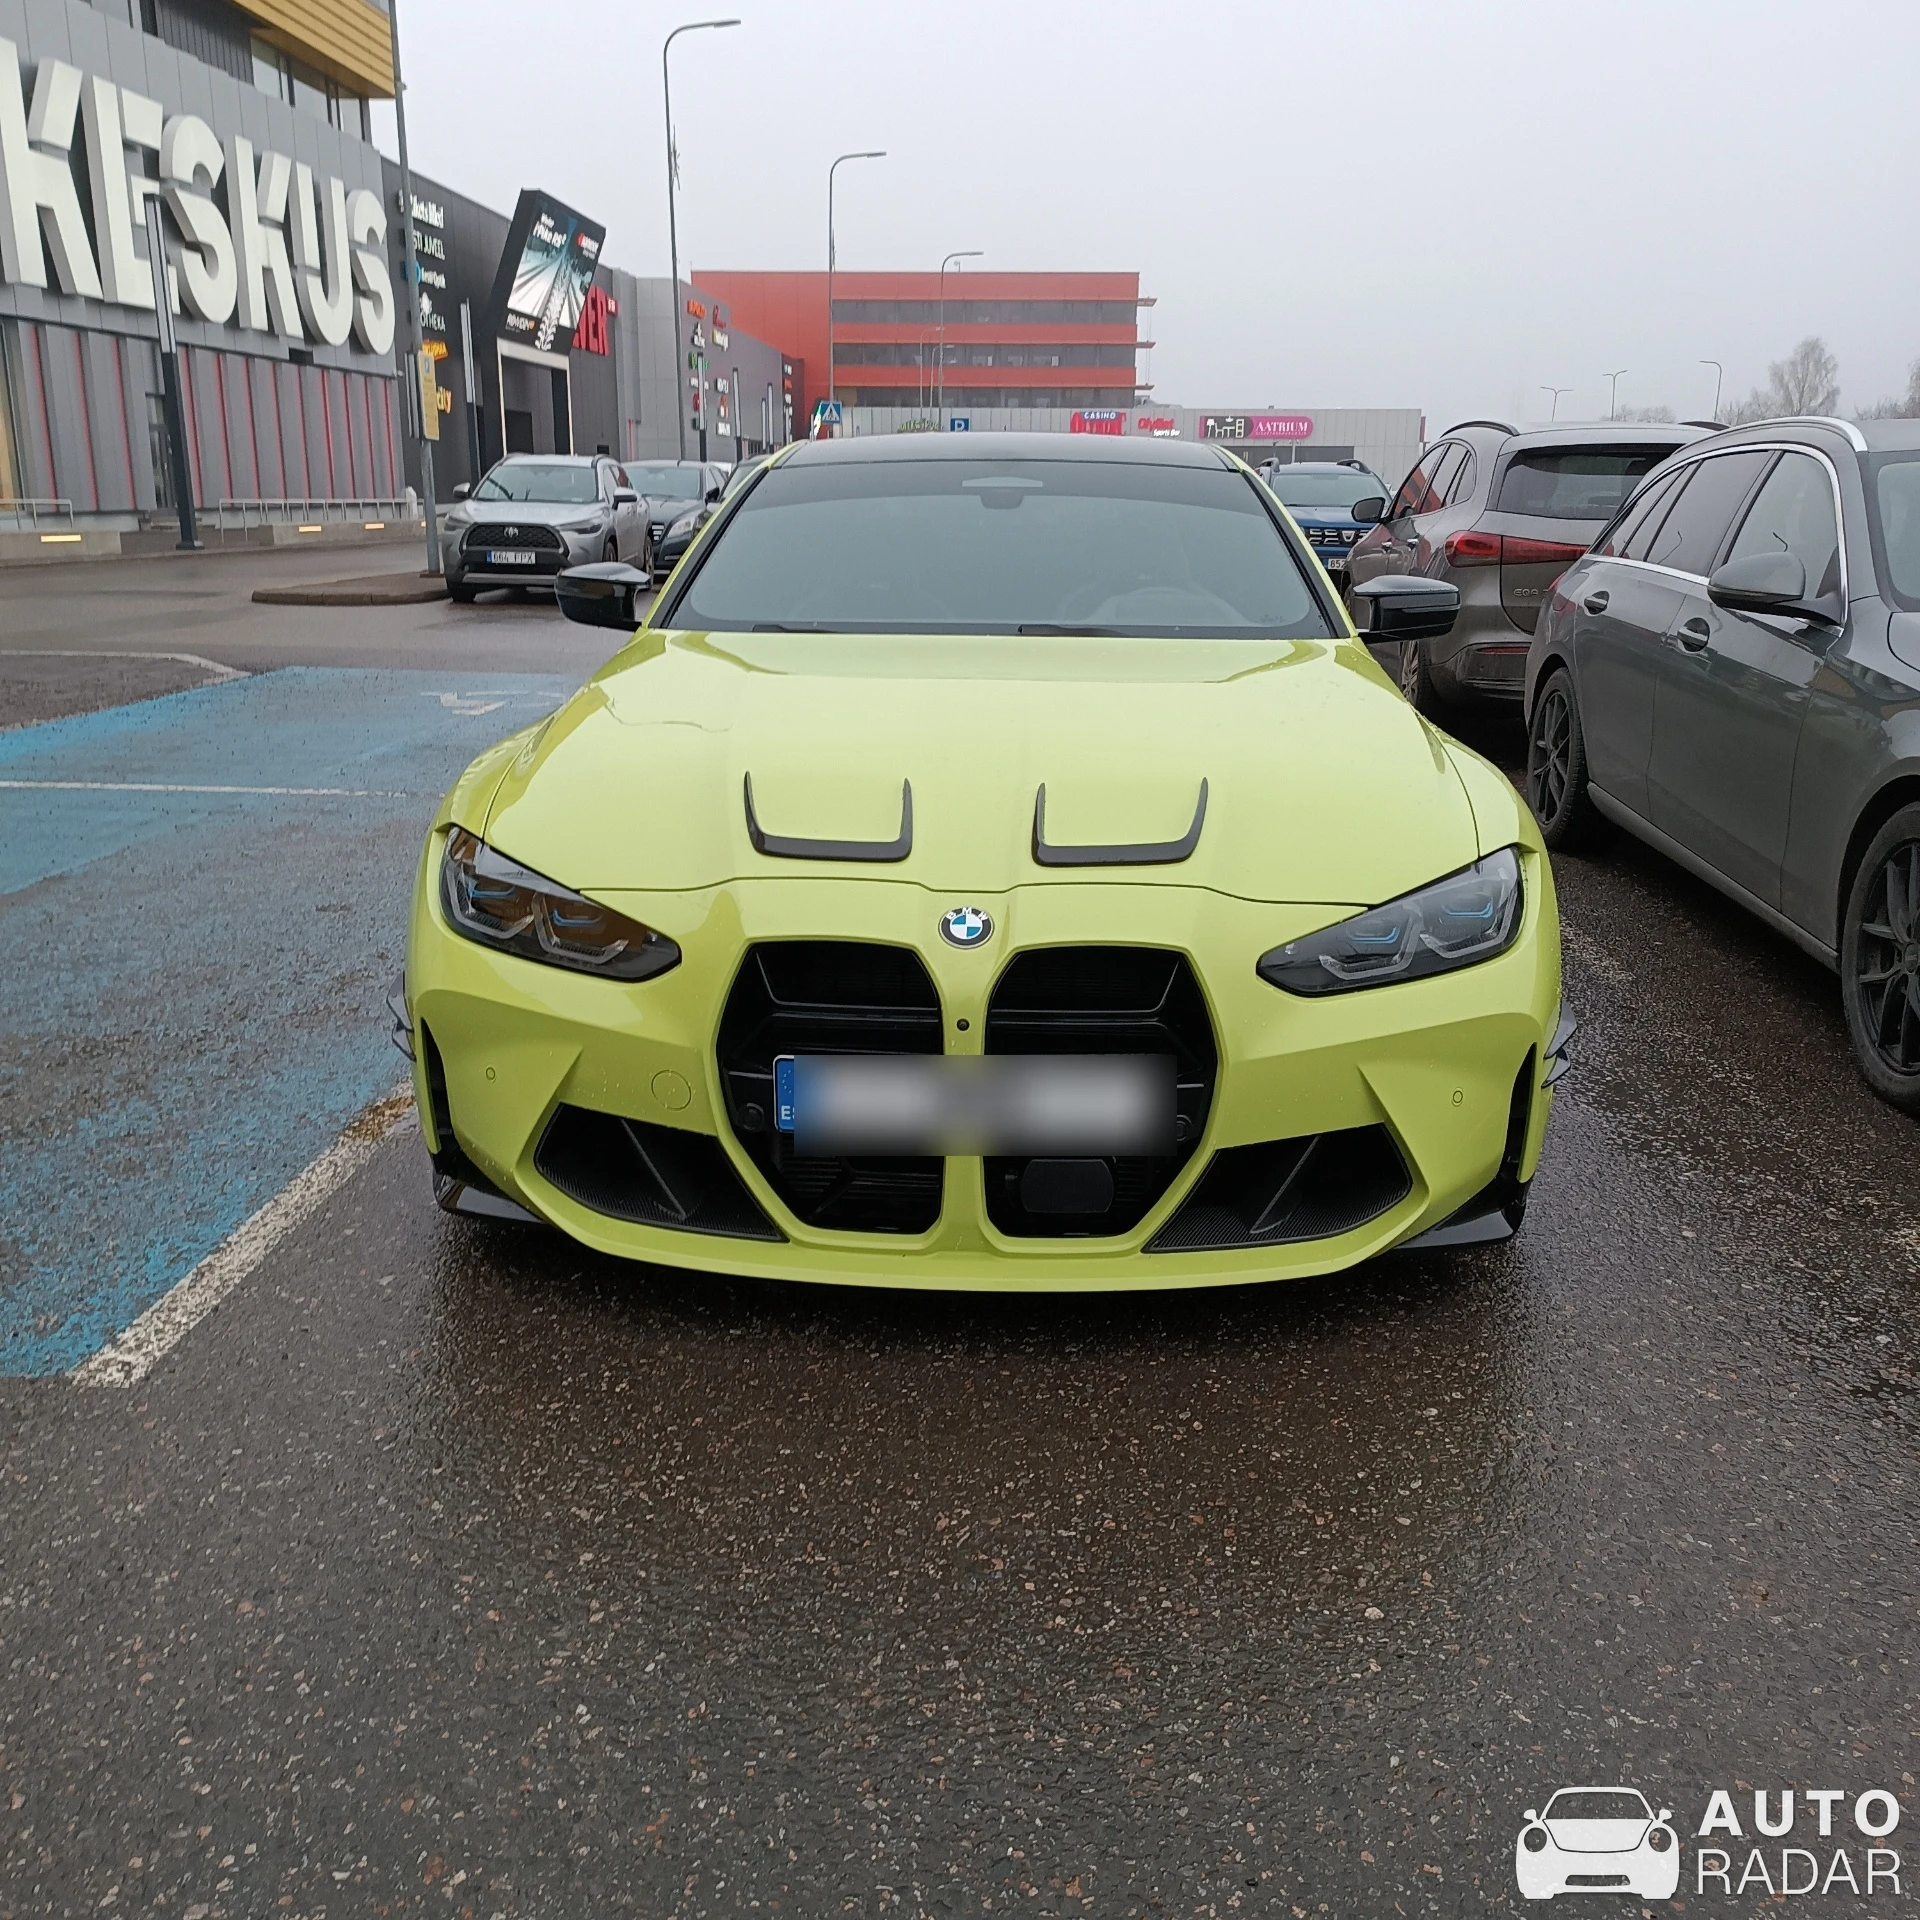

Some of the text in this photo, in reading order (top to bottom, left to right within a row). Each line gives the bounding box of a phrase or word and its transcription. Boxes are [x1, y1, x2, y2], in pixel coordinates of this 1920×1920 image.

[0, 36, 396, 356] KESKUS
[1083, 411, 1117, 420] CASINO
[1255, 421, 1308, 432] AATRIUM
[946, 906, 989, 920] BMW
